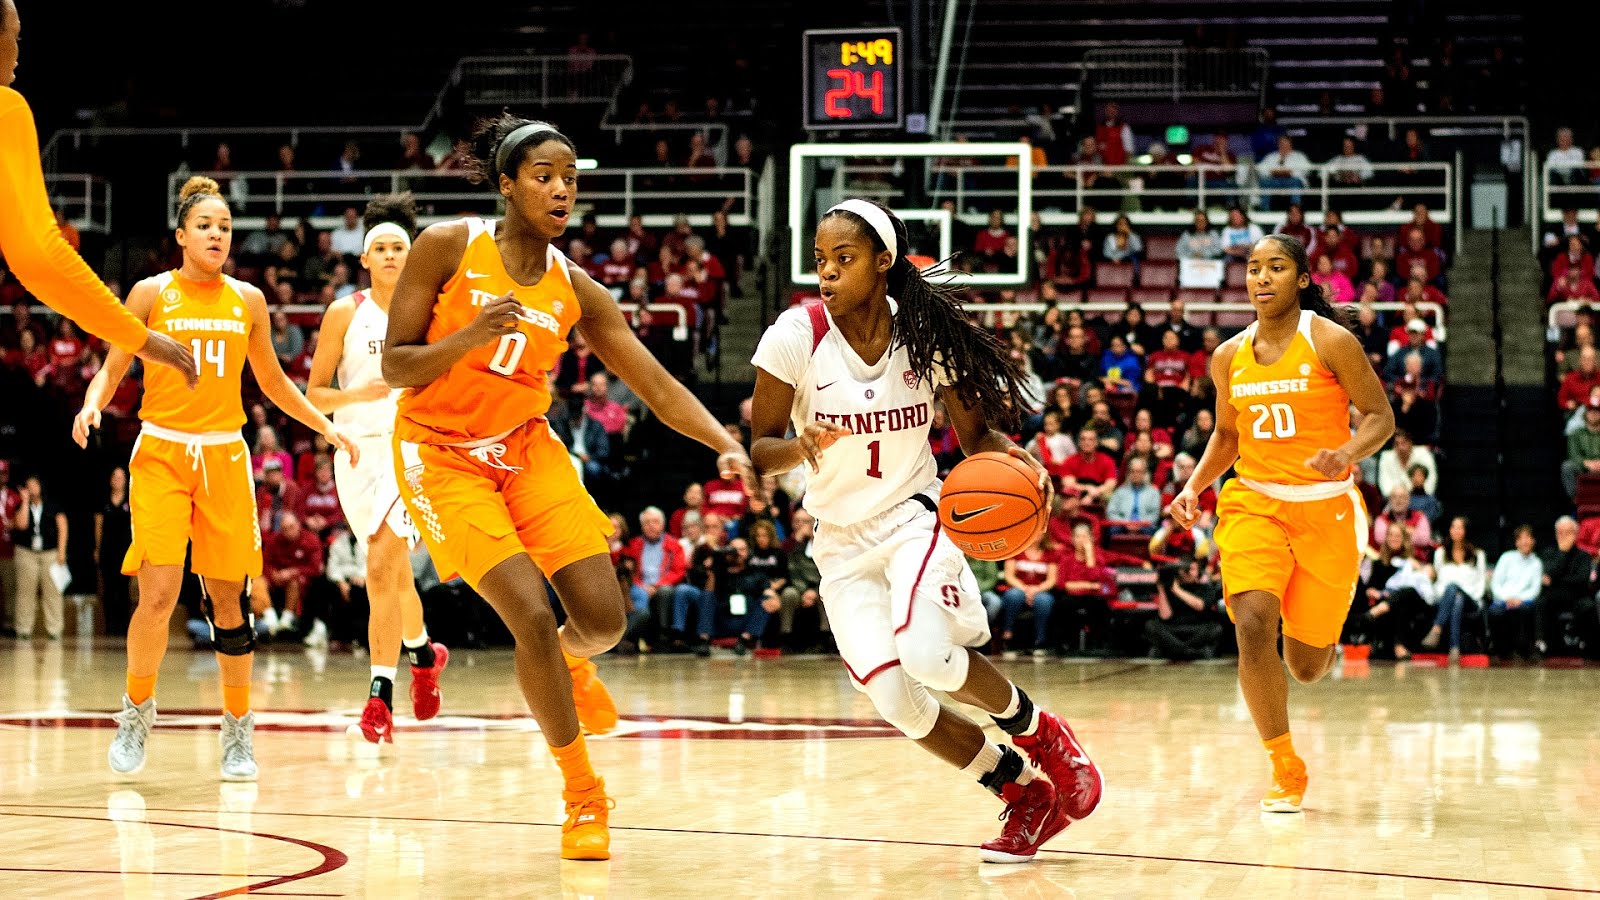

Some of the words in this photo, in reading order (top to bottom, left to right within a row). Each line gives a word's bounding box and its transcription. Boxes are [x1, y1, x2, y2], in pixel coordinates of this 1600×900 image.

[841, 39, 893, 66] 1:49
[824, 69, 884, 118] 24
[165, 317, 246, 335] TENNESSEE
[190, 338, 226, 378] 14
[488, 330, 528, 376] 0
[1231, 378, 1309, 399] TENNESSEE
[1248, 403, 1297, 439] 20
[866, 440, 883, 479] 1
[941, 584, 960, 608] S
